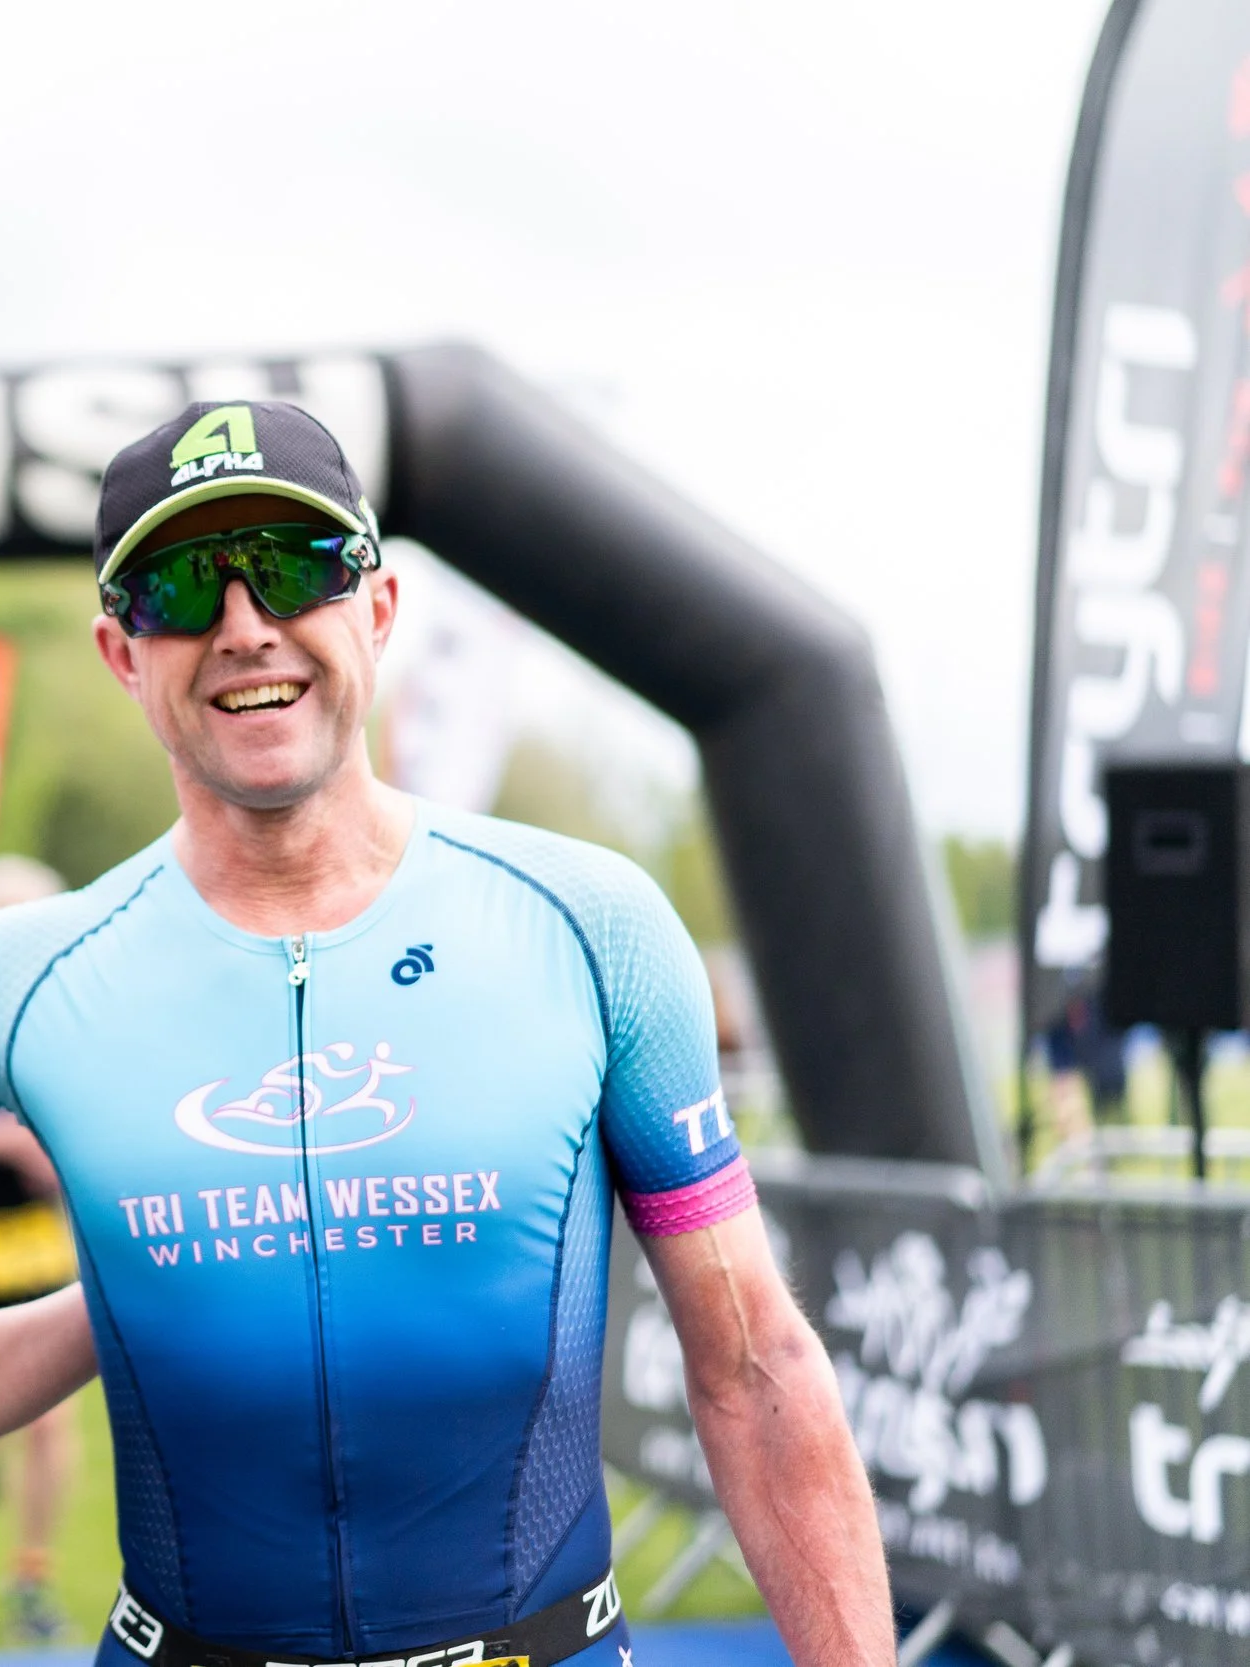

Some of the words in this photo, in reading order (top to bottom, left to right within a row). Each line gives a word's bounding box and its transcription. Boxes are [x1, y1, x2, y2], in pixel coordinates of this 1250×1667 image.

[170, 451, 264, 488] ALPHA
[118, 1192, 186, 1239] TRI
[197, 1181, 310, 1231] TEAM
[324, 1169, 503, 1220] WESSEX
[146, 1221, 478, 1268] WINCHESTER
